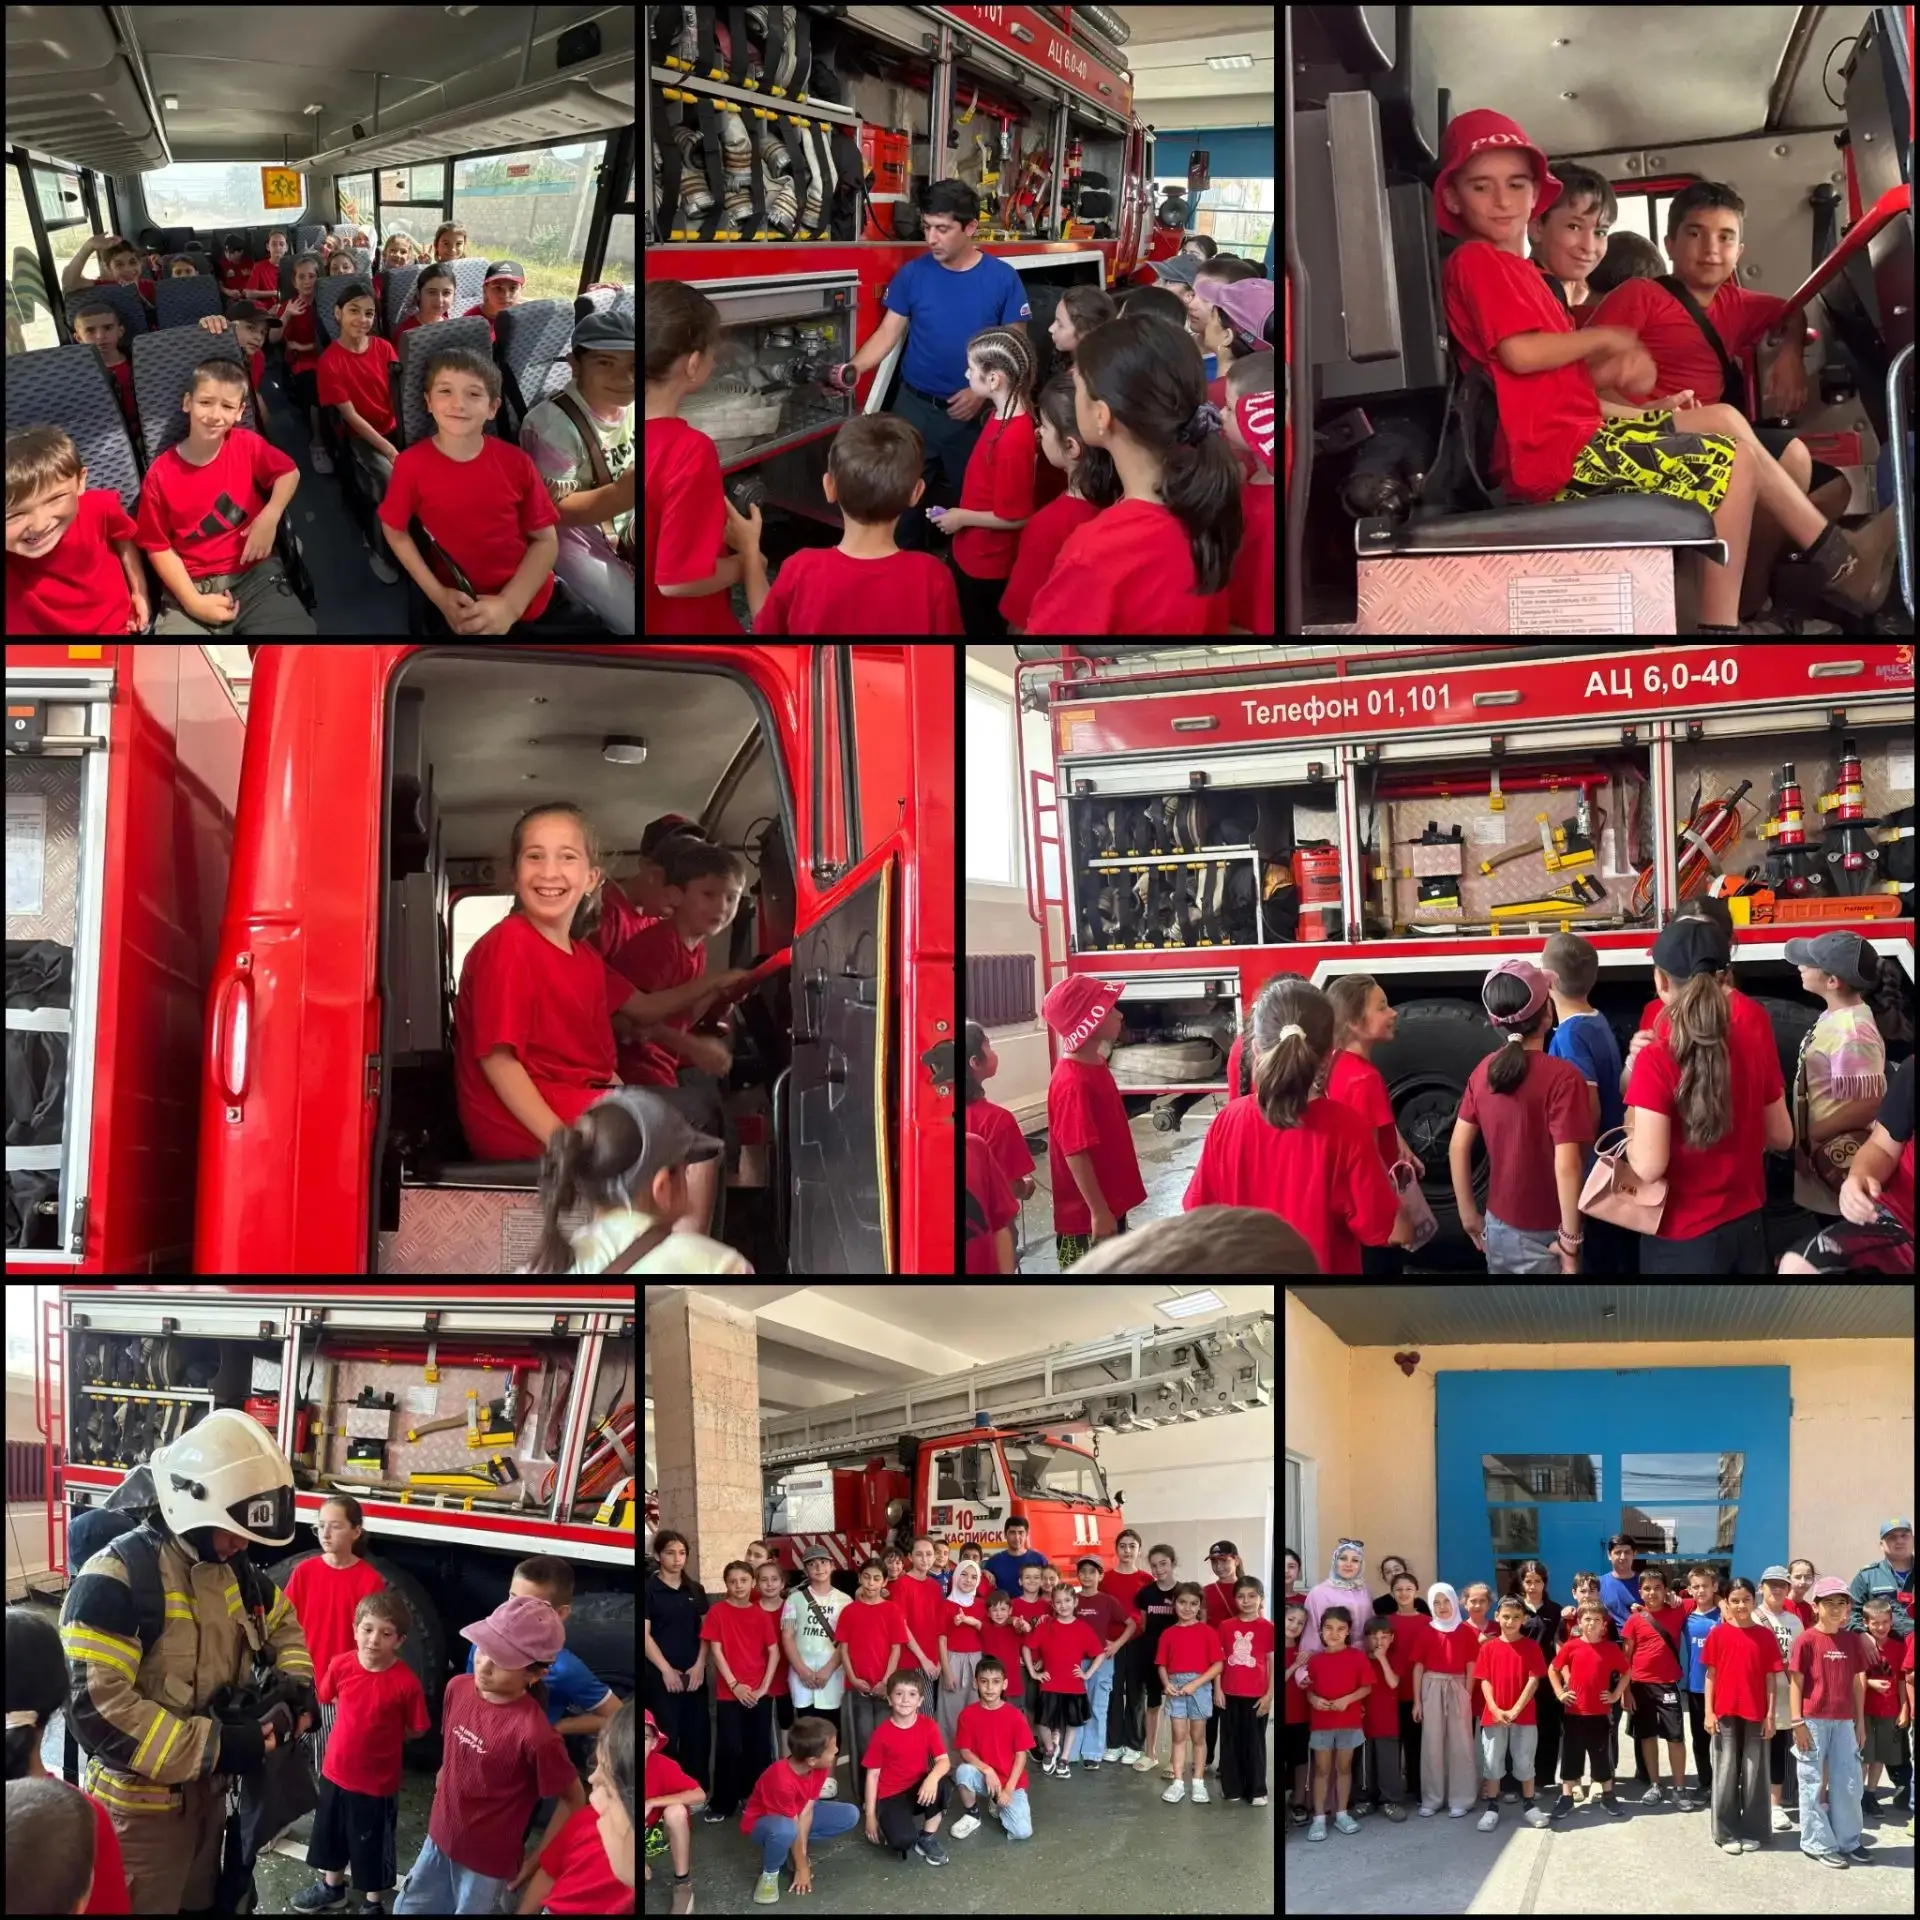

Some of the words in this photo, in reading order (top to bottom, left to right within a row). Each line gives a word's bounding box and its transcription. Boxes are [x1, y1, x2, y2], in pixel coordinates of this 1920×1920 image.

[1047, 38, 1063, 68] АЦ
[1584, 671, 1633, 699] АЦ
[1643, 658, 1739, 695] 6,0-40
[1241, 695, 1359, 727] Телефон
[1367, 683, 1451, 718] 01,101
[251, 1504, 270, 1523] 10
[956, 1509, 973, 1531] 10
[945, 1529, 1002, 1544] КАСПИЙСК
